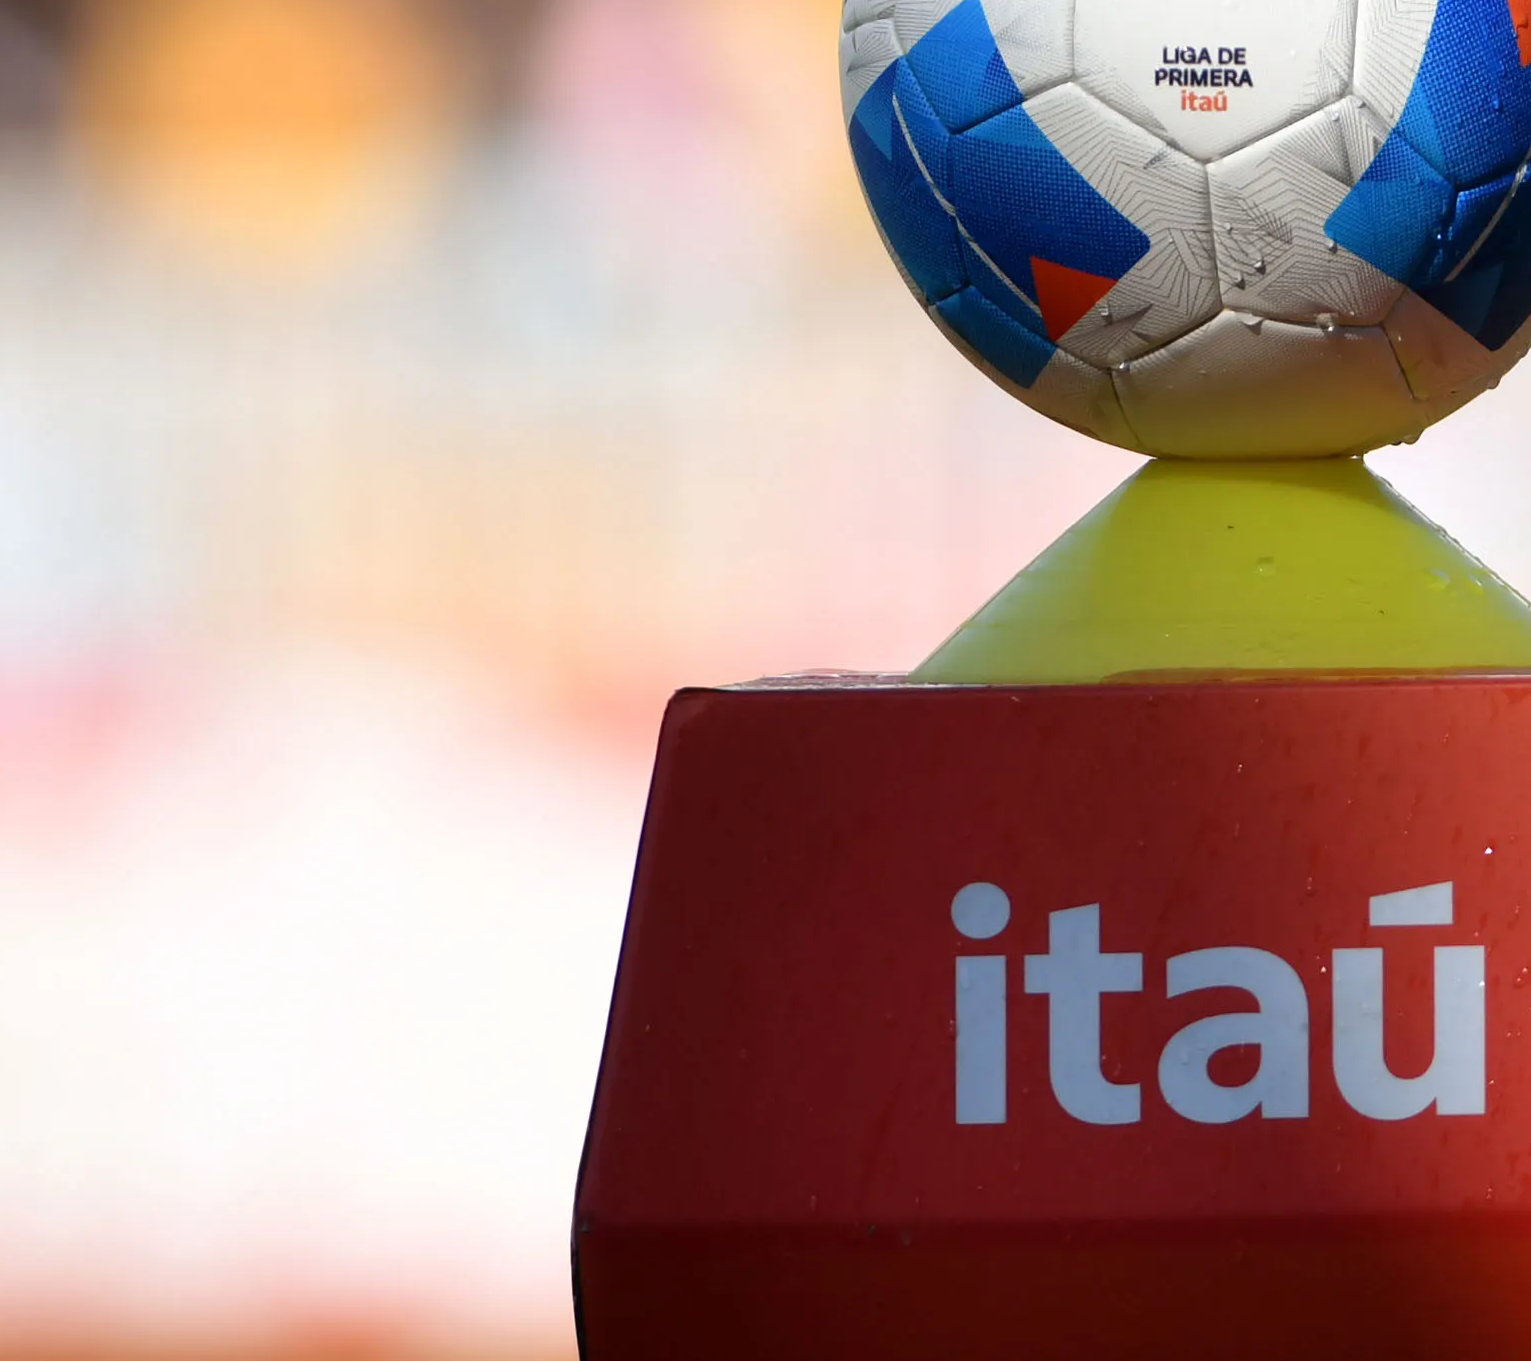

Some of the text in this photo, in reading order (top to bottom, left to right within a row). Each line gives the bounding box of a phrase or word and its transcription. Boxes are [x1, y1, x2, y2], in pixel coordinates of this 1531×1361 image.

[1162, 45, 1247, 65] LIGA DE
[1154, 67, 1254, 88] PRIMERA
[1180, 89, 1228, 112] itaú
[950, 880, 1487, 1125] itaú
